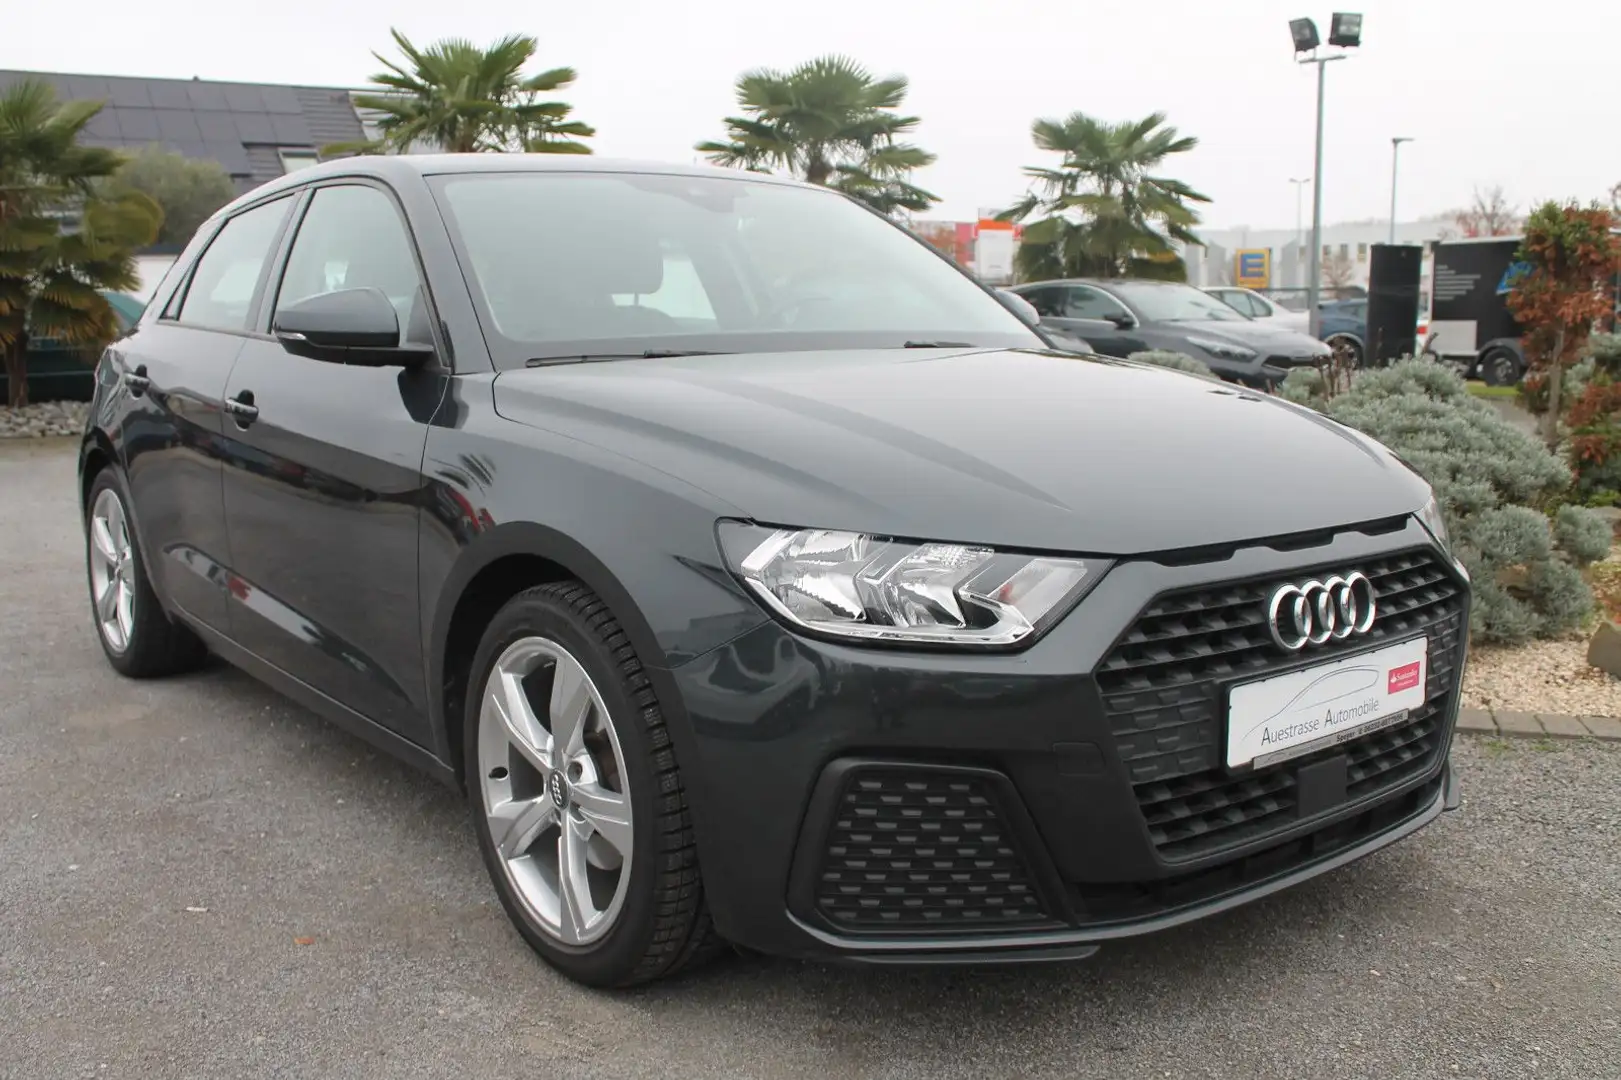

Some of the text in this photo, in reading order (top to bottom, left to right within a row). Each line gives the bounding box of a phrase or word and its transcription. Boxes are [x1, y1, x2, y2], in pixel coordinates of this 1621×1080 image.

[1241, 253, 1265, 277] E
[1261, 719, 1320, 746] Auestrasse
[1324, 698, 1379, 727] Automobile
